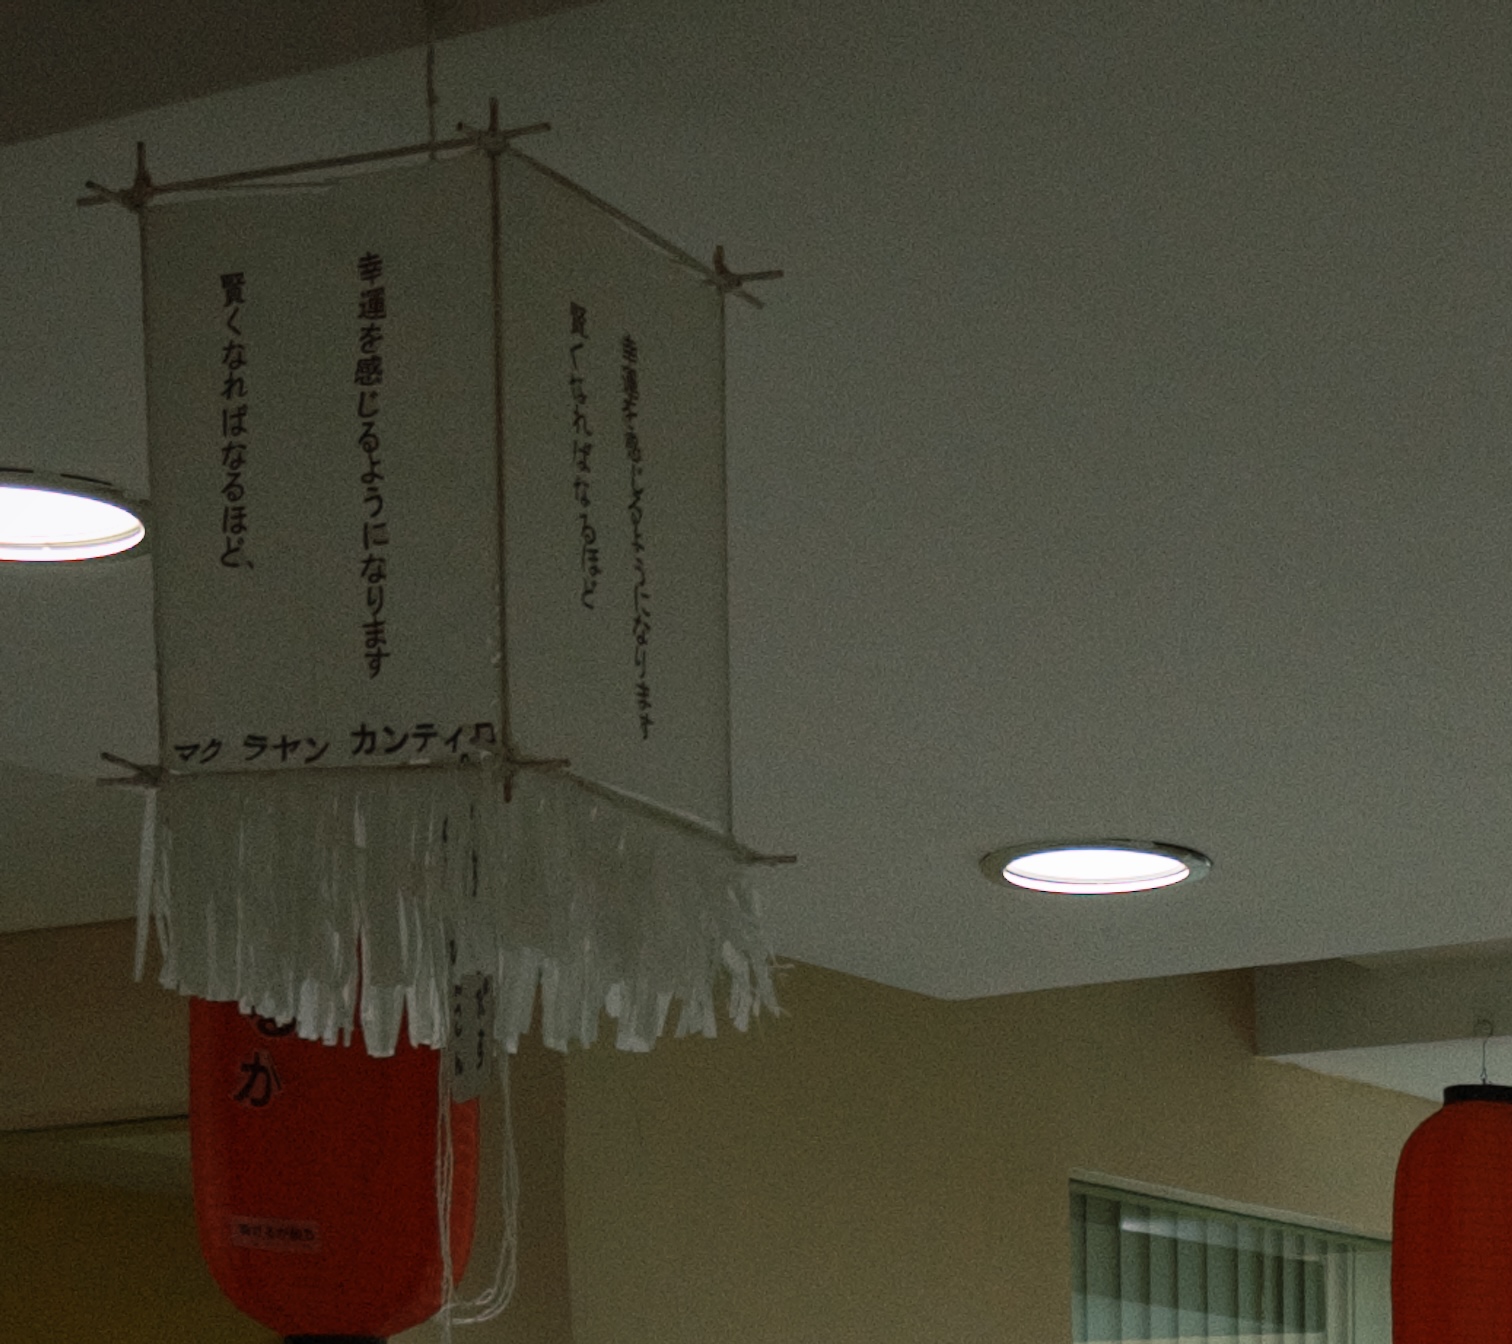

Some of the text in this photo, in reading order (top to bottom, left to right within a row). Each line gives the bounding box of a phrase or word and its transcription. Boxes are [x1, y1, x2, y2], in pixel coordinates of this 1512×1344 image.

[354, 251, 391, 680] 幸運を感じるようになります
[243, 733, 330, 764] ラヤン
